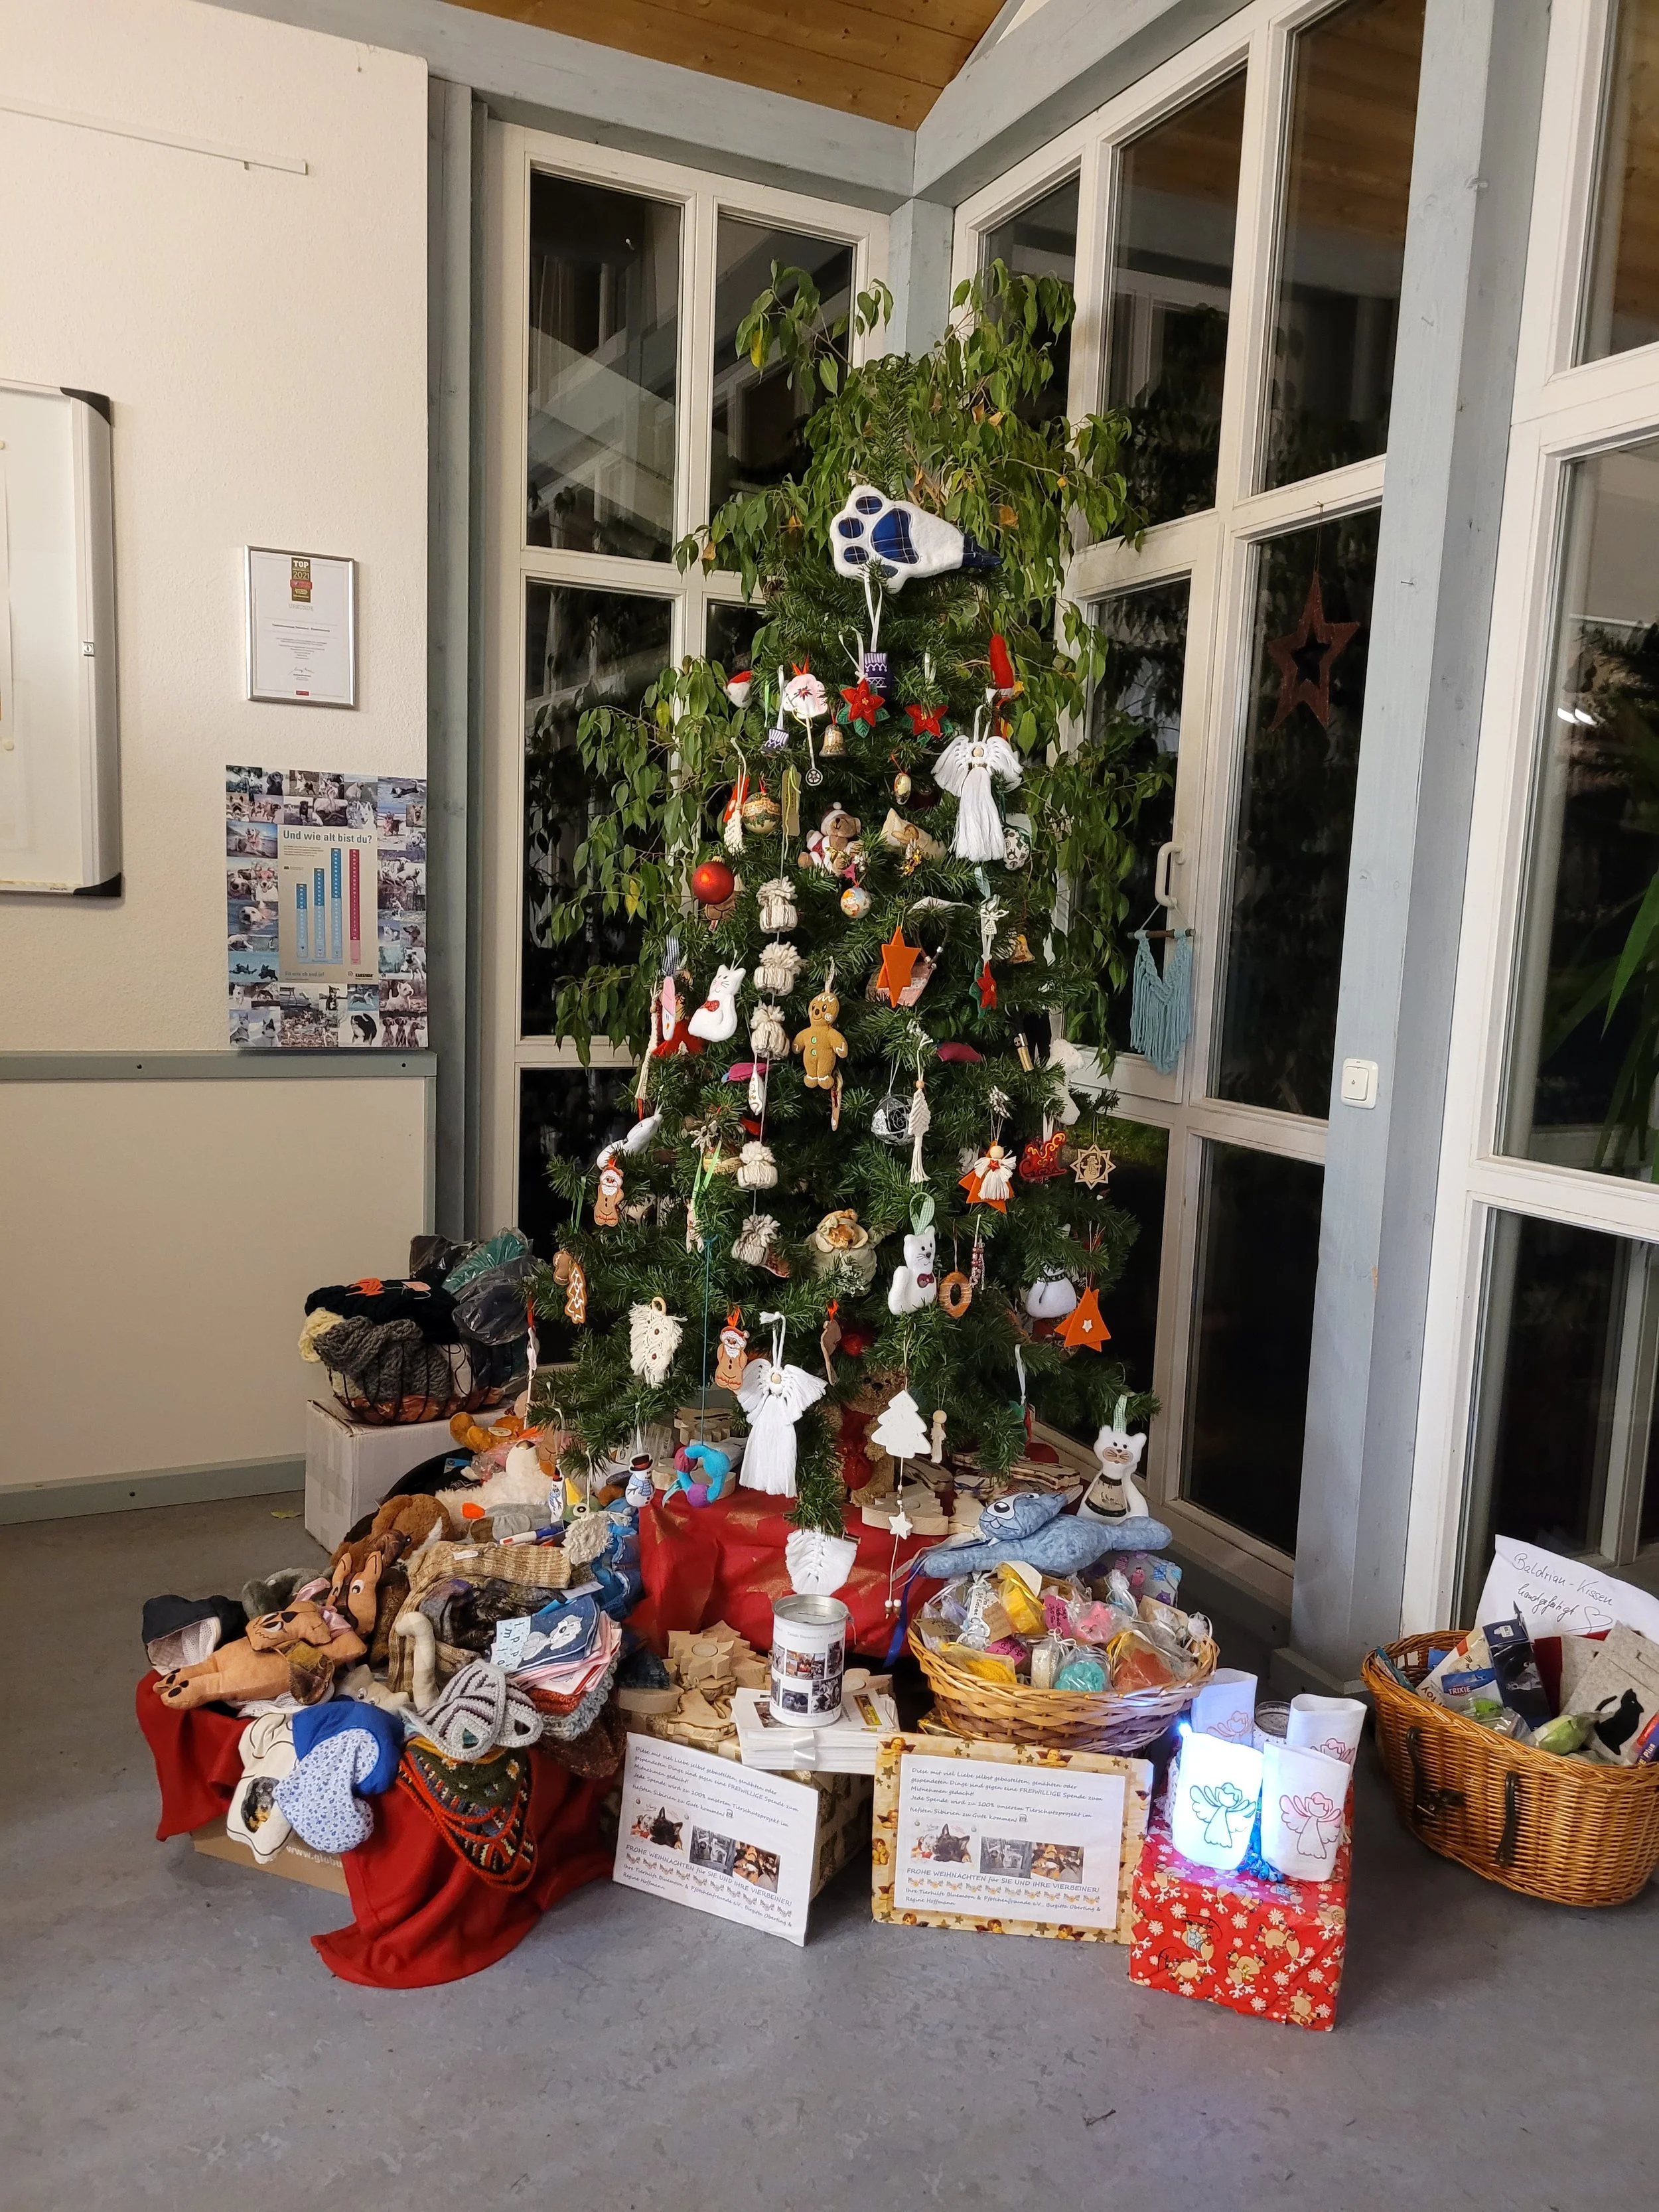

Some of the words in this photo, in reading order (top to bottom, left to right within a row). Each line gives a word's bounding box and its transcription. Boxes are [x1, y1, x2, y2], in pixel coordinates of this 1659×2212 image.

[293, 560, 309, 569] TOP
[293, 571, 310, 579] 2021
[283, 830, 301, 840] Und
[303, 832, 321, 841] wie
[323, 832, 336, 842] alt
[338, 833, 354, 843] bist
[356, 834, 372, 844] du?
[1511, 1552, 1567, 1587] Baldrian
[1576, 1579, 1613, 1606] Kissen
[1447, 1685, 1472, 1696] TRIXIE
[634, 1745, 650, 1754] Diese
[674, 1757, 689, 1766] Liebe
[689, 1763, 705, 1771] selbst
[1642, 1743, 1656, 1758] Plus
[634, 1755, 667, 1768] gespendeten
[667, 1763, 684, 1774] Dinge
[697, 1774, 713, 1783] gegen
[727, 1783, 763, 1800] FREIWILLIGE
[764, 1795, 785, 1807] Spende
[646, 1775, 666, 1787] Spende
[690, 1789, 706, 1799] 100%
[706, 1796, 731, 1806] unserem
[910, 1785, 948, 1794] Mitnehmen
[949, 1779, 968, 1788] Dinge
[1019, 1787, 1061, 1797] FREIWILLIGE
[1062, 1791, 1086, 1800] Spende
[652, 1789, 676, 1801] Sibirien
[685, 1800, 699, 1808] Gute
[625, 1844, 648, 1855] FROHE
[648, 1851, 695, 1872] WEIHNACHTEN
[718, 1874, 733, 1883] UND
[733, 1880, 749, 1891] IHRE
[750, 1886, 792, 1907] VIERBEINER!
[906, 1867, 931, 1876] FROHE
[932, 1870, 986, 1881] WEIHNACHTEN
[1052, 1882, 1100, 1893] VIERBEINER!
